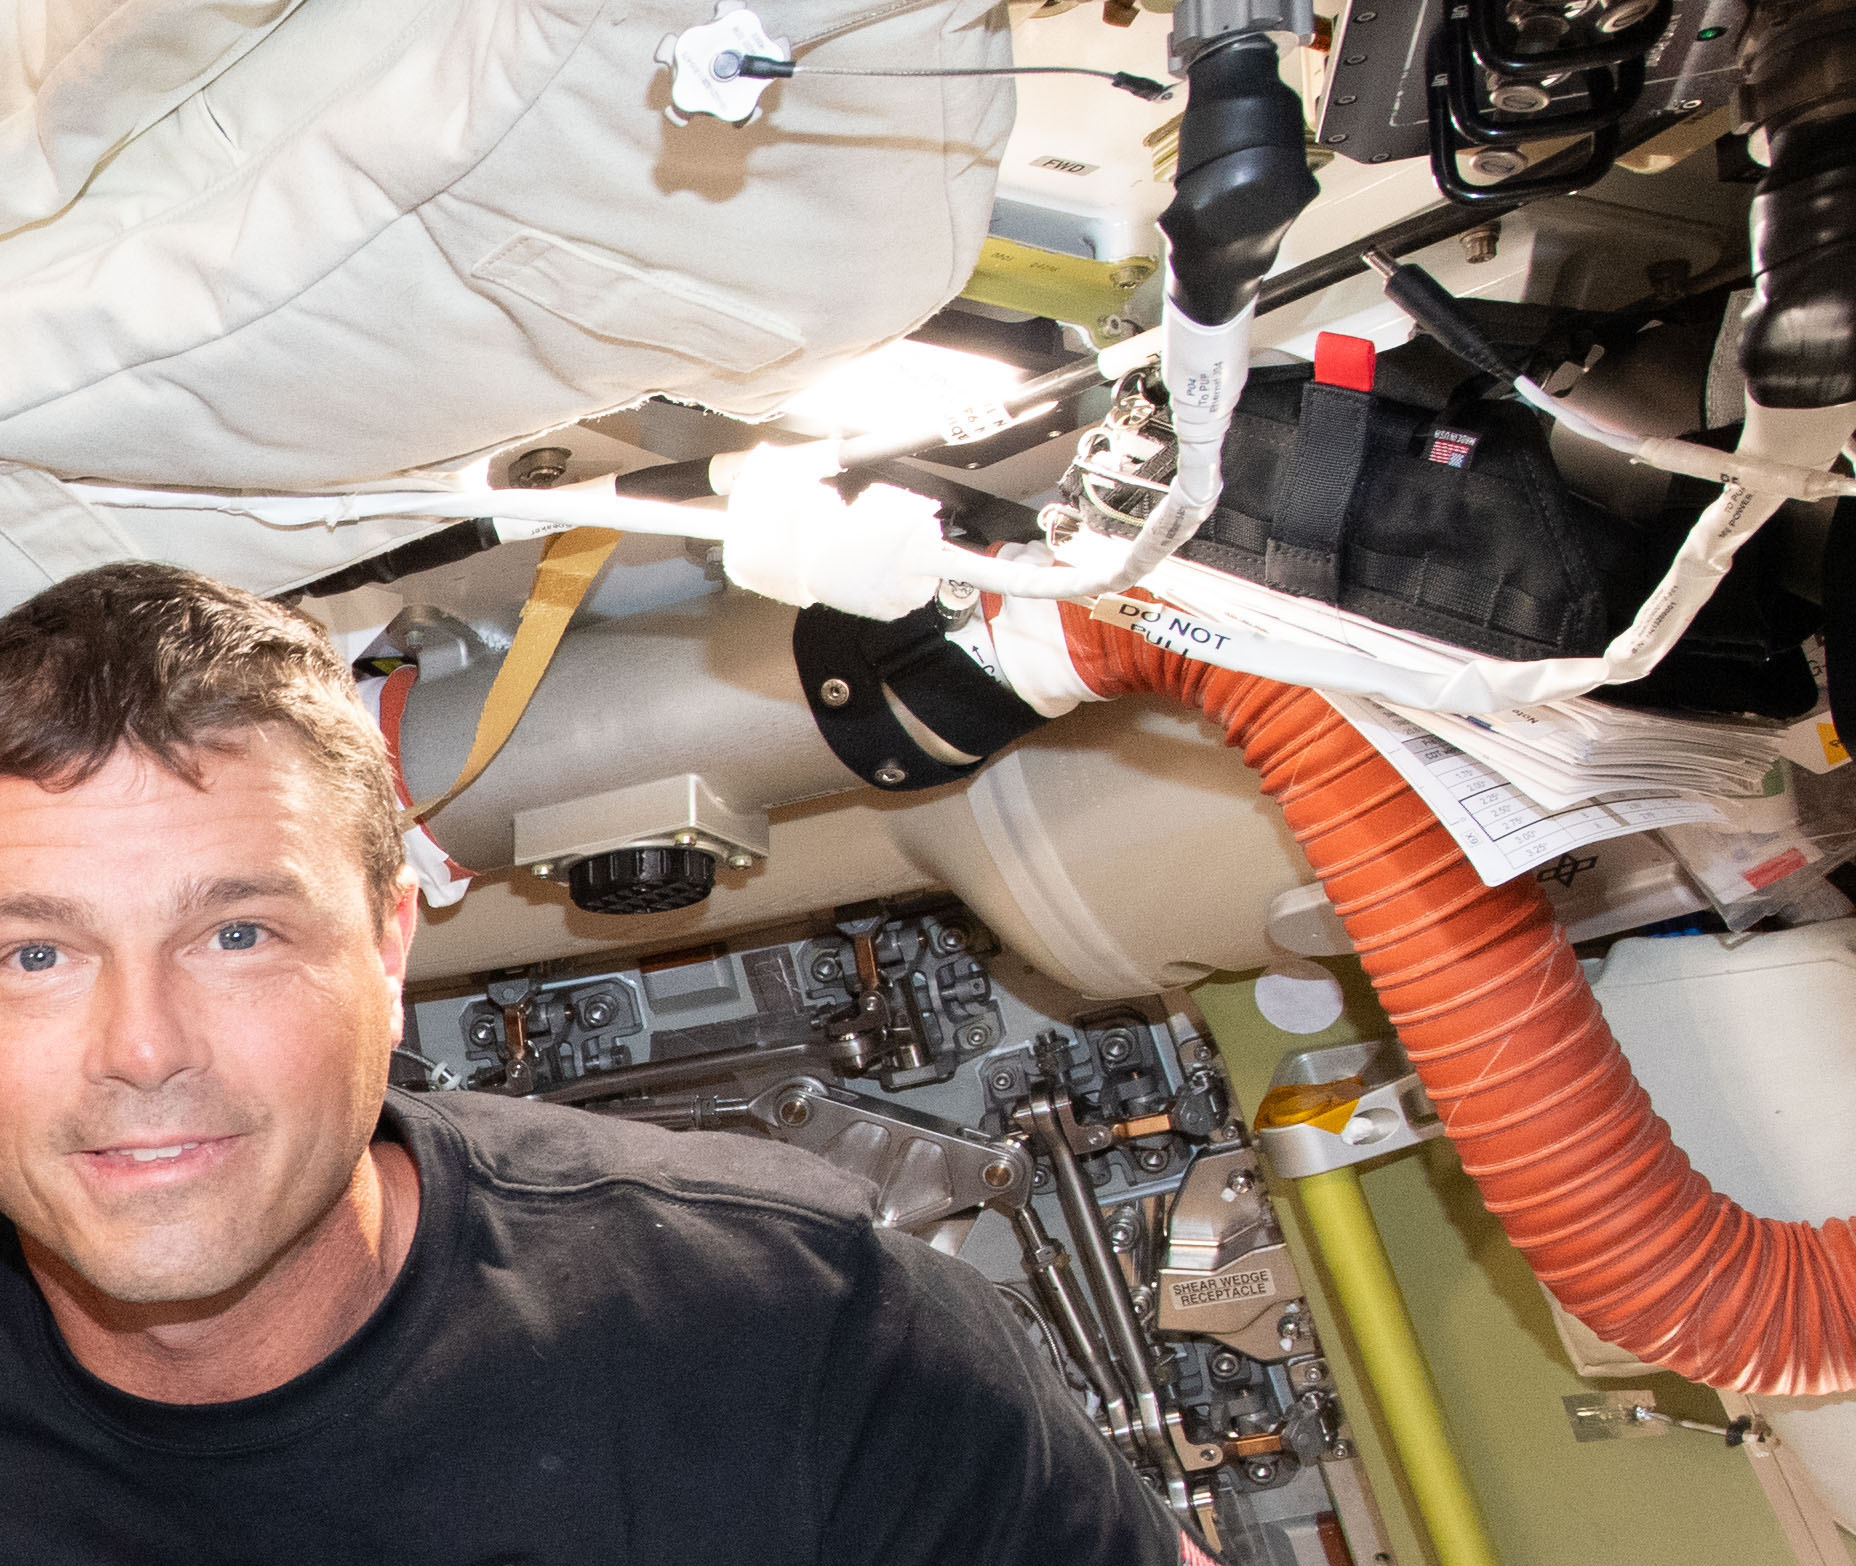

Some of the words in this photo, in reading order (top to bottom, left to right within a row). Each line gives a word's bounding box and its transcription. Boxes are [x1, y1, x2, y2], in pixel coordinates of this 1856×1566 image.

[1043, 159, 1085, 173] FWD
[1119, 603, 1161, 623] DO
[1169, 617, 1231, 650] NOT
[1172, 1278, 1218, 1295] SHEAR
[1219, 1270, 1269, 1287] WEDGE
[1181, 1283, 1267, 1307] RECEPTACLE
